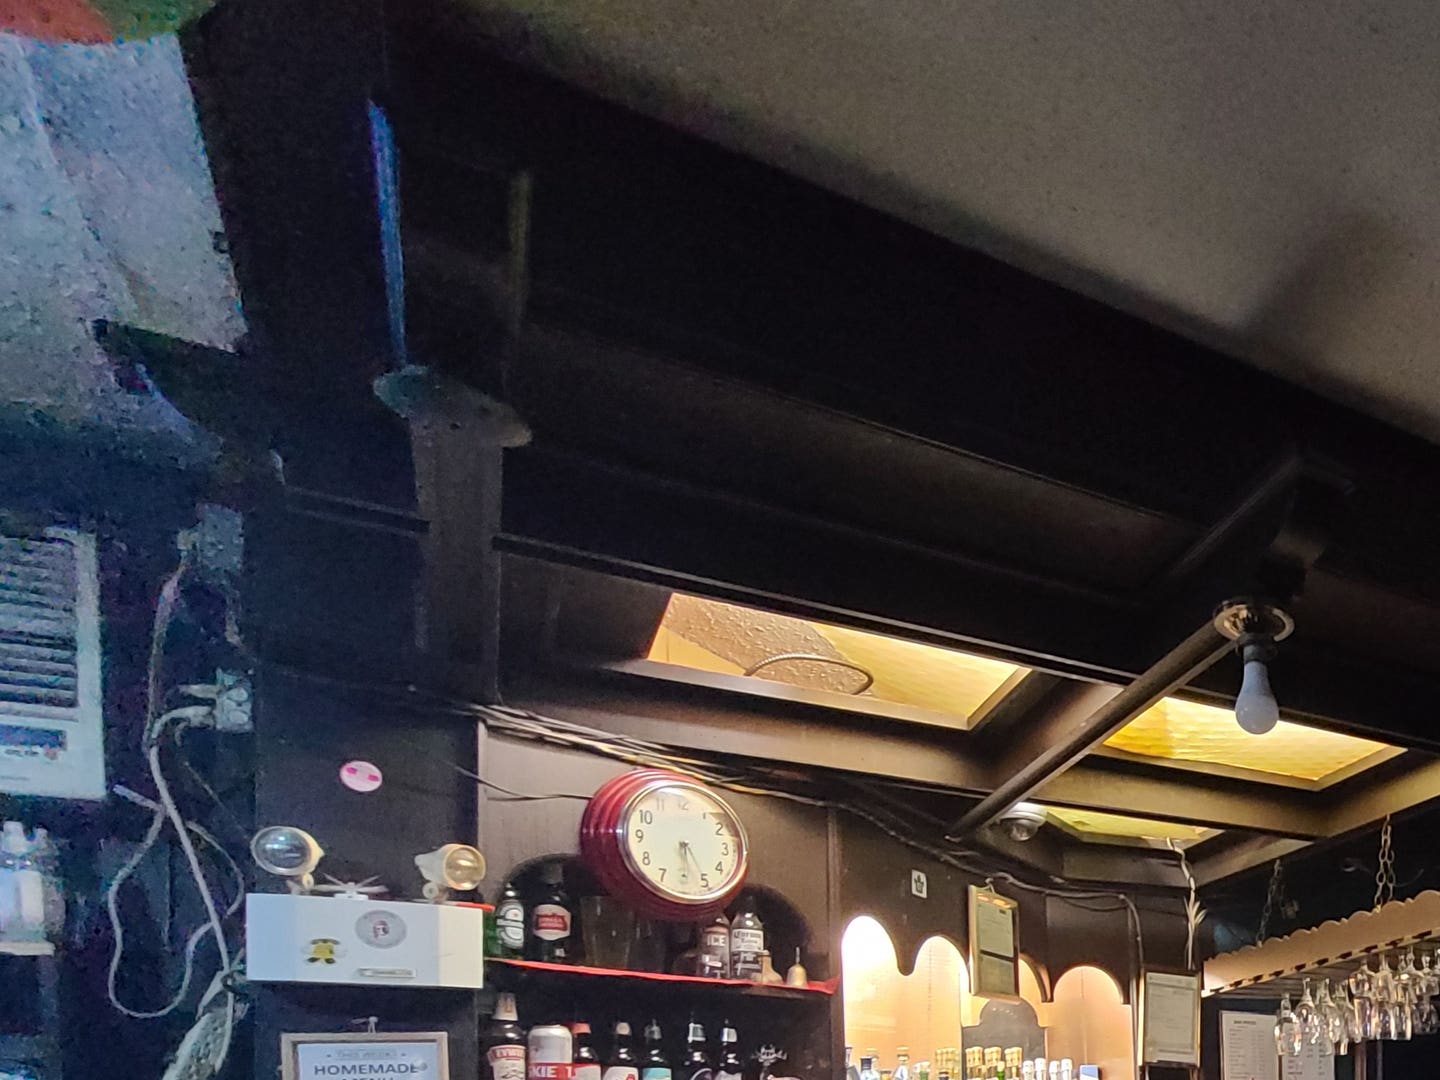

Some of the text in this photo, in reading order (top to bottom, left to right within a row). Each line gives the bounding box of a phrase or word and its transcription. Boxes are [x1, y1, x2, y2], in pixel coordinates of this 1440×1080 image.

[678, 799, 689, 812] 12
[639, 809, 653, 825] 10
[635, 829, 644, 843] 9
[715, 822, 724, 836] 2
[721, 842, 729, 856] 3
[642, 851, 651, 866] 8
[715, 861, 724, 875] 4
[658, 868, 668, 883] 7
[700, 873, 709, 888] 5
[314, 1063, 418, 1076] HOMEMADE
